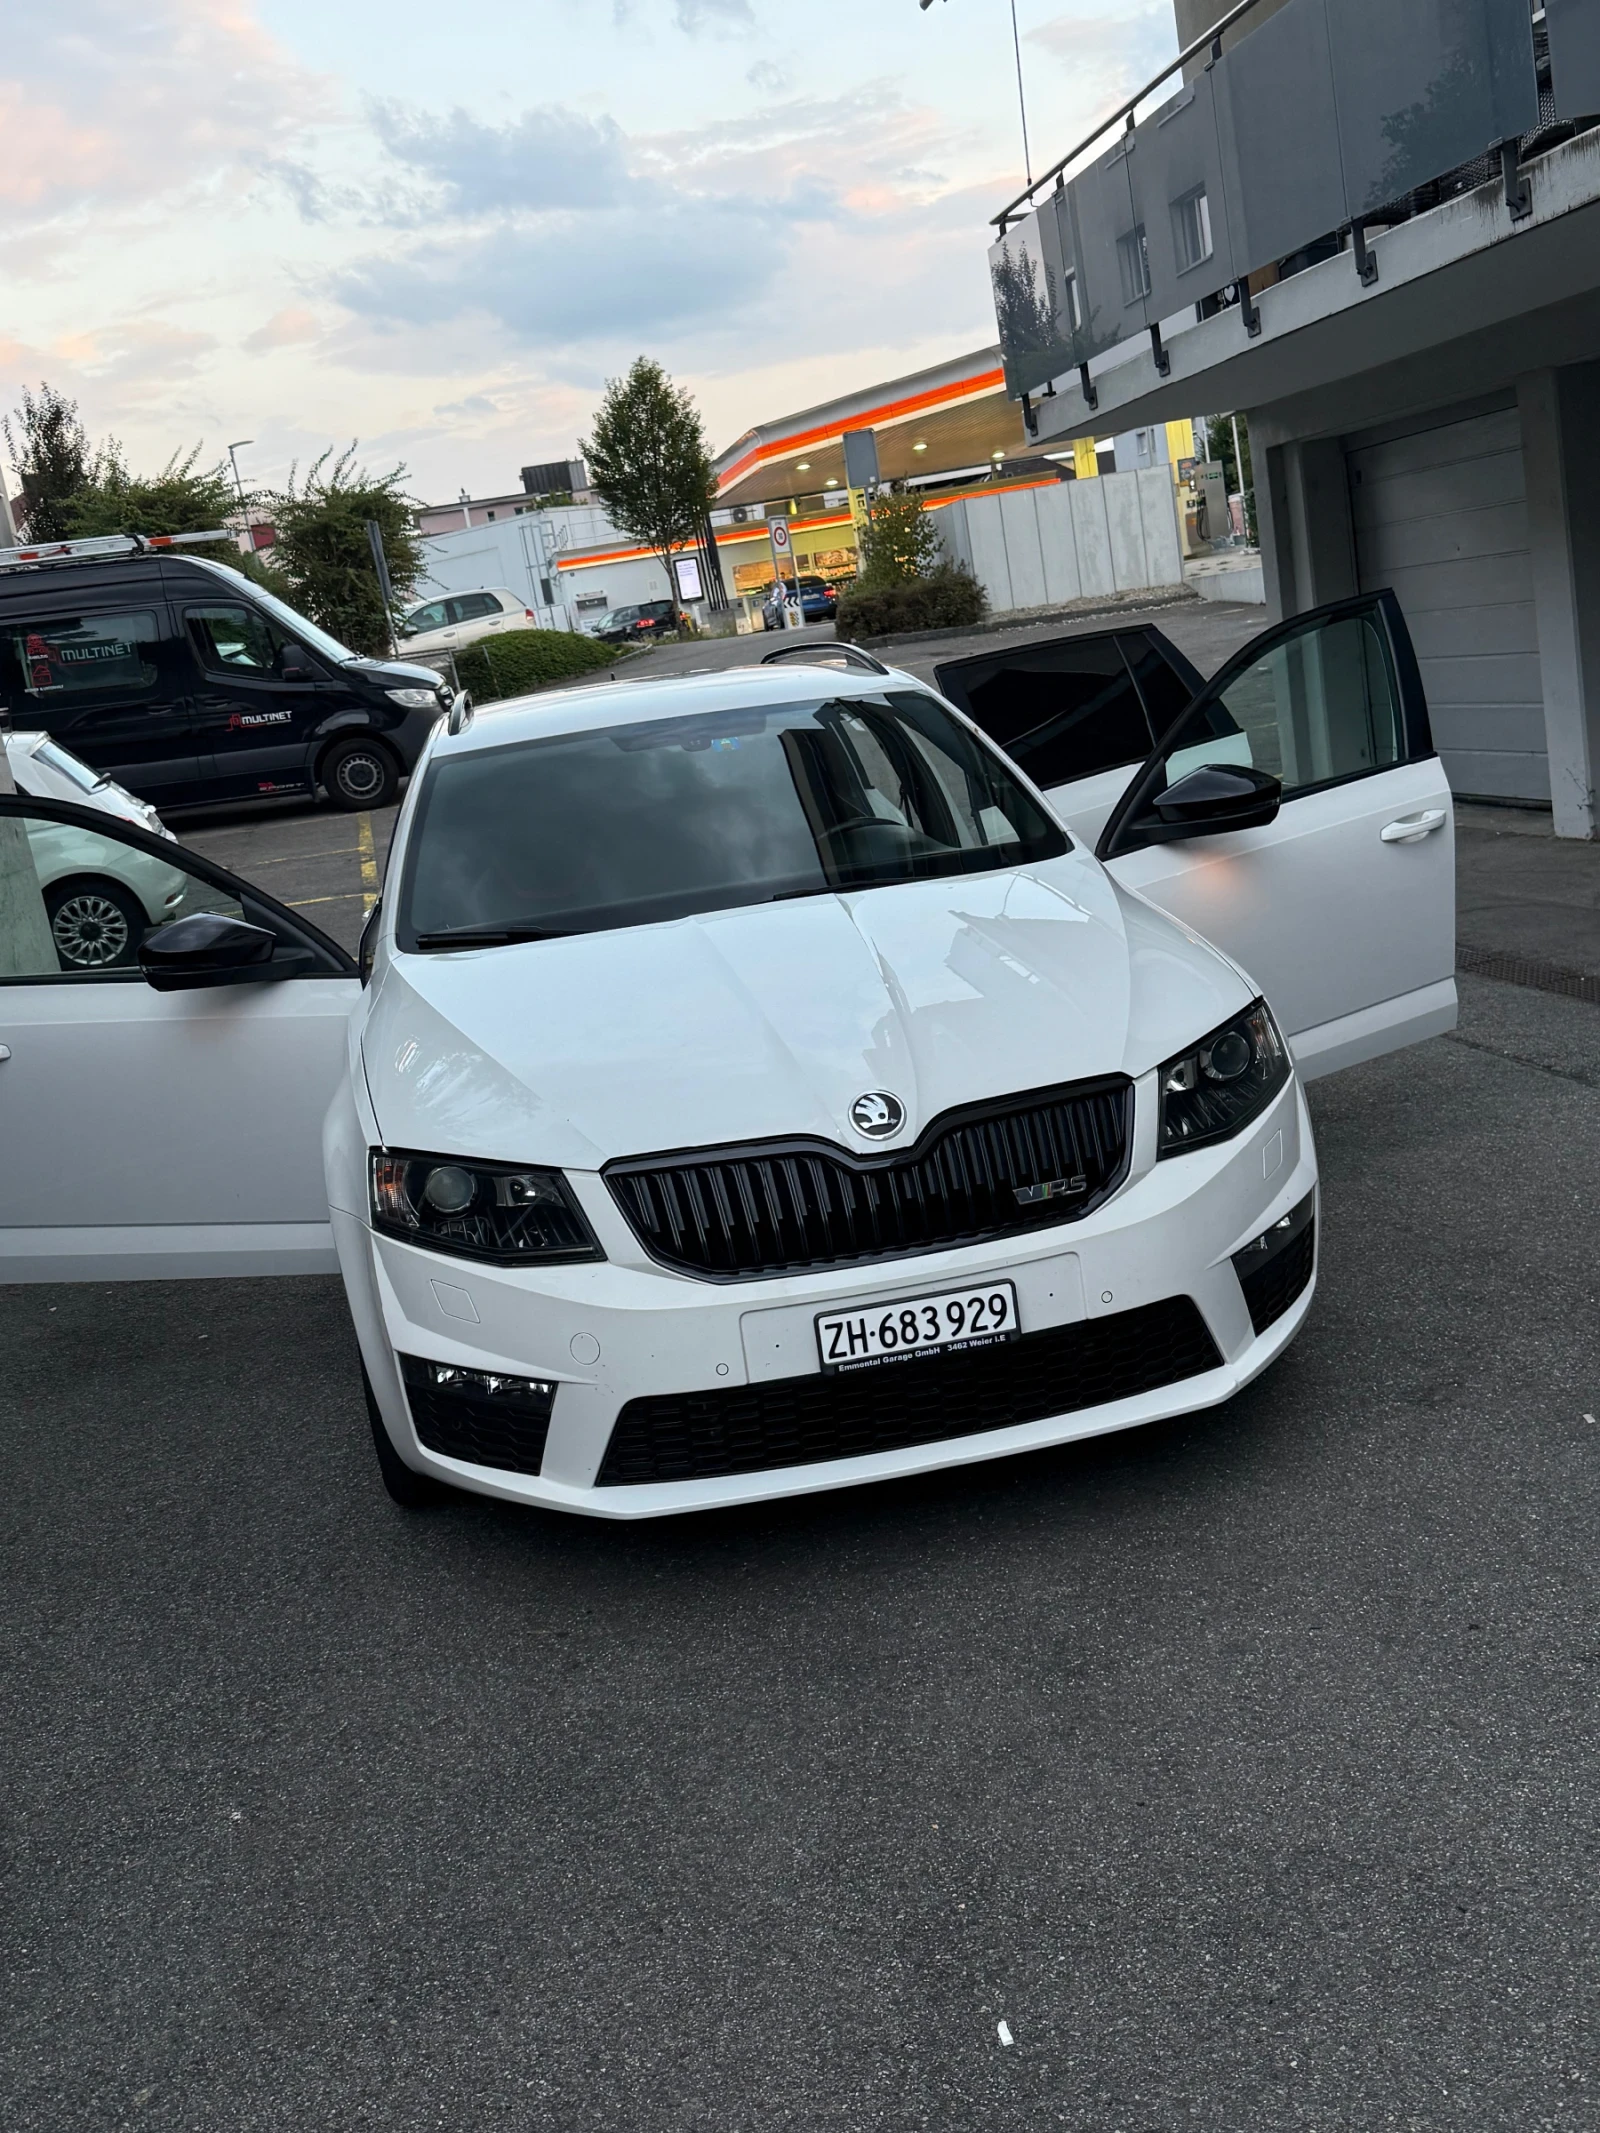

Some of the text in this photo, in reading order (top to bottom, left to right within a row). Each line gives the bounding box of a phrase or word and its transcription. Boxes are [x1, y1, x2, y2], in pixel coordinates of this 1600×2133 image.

[61, 642, 132, 661] MULTINET
[241, 710, 292, 725] MULTINET
[882, 1352, 913, 1364] Garage
[915, 1346, 941, 1357] GmbH
[947, 1342, 968, 1352] 3462
